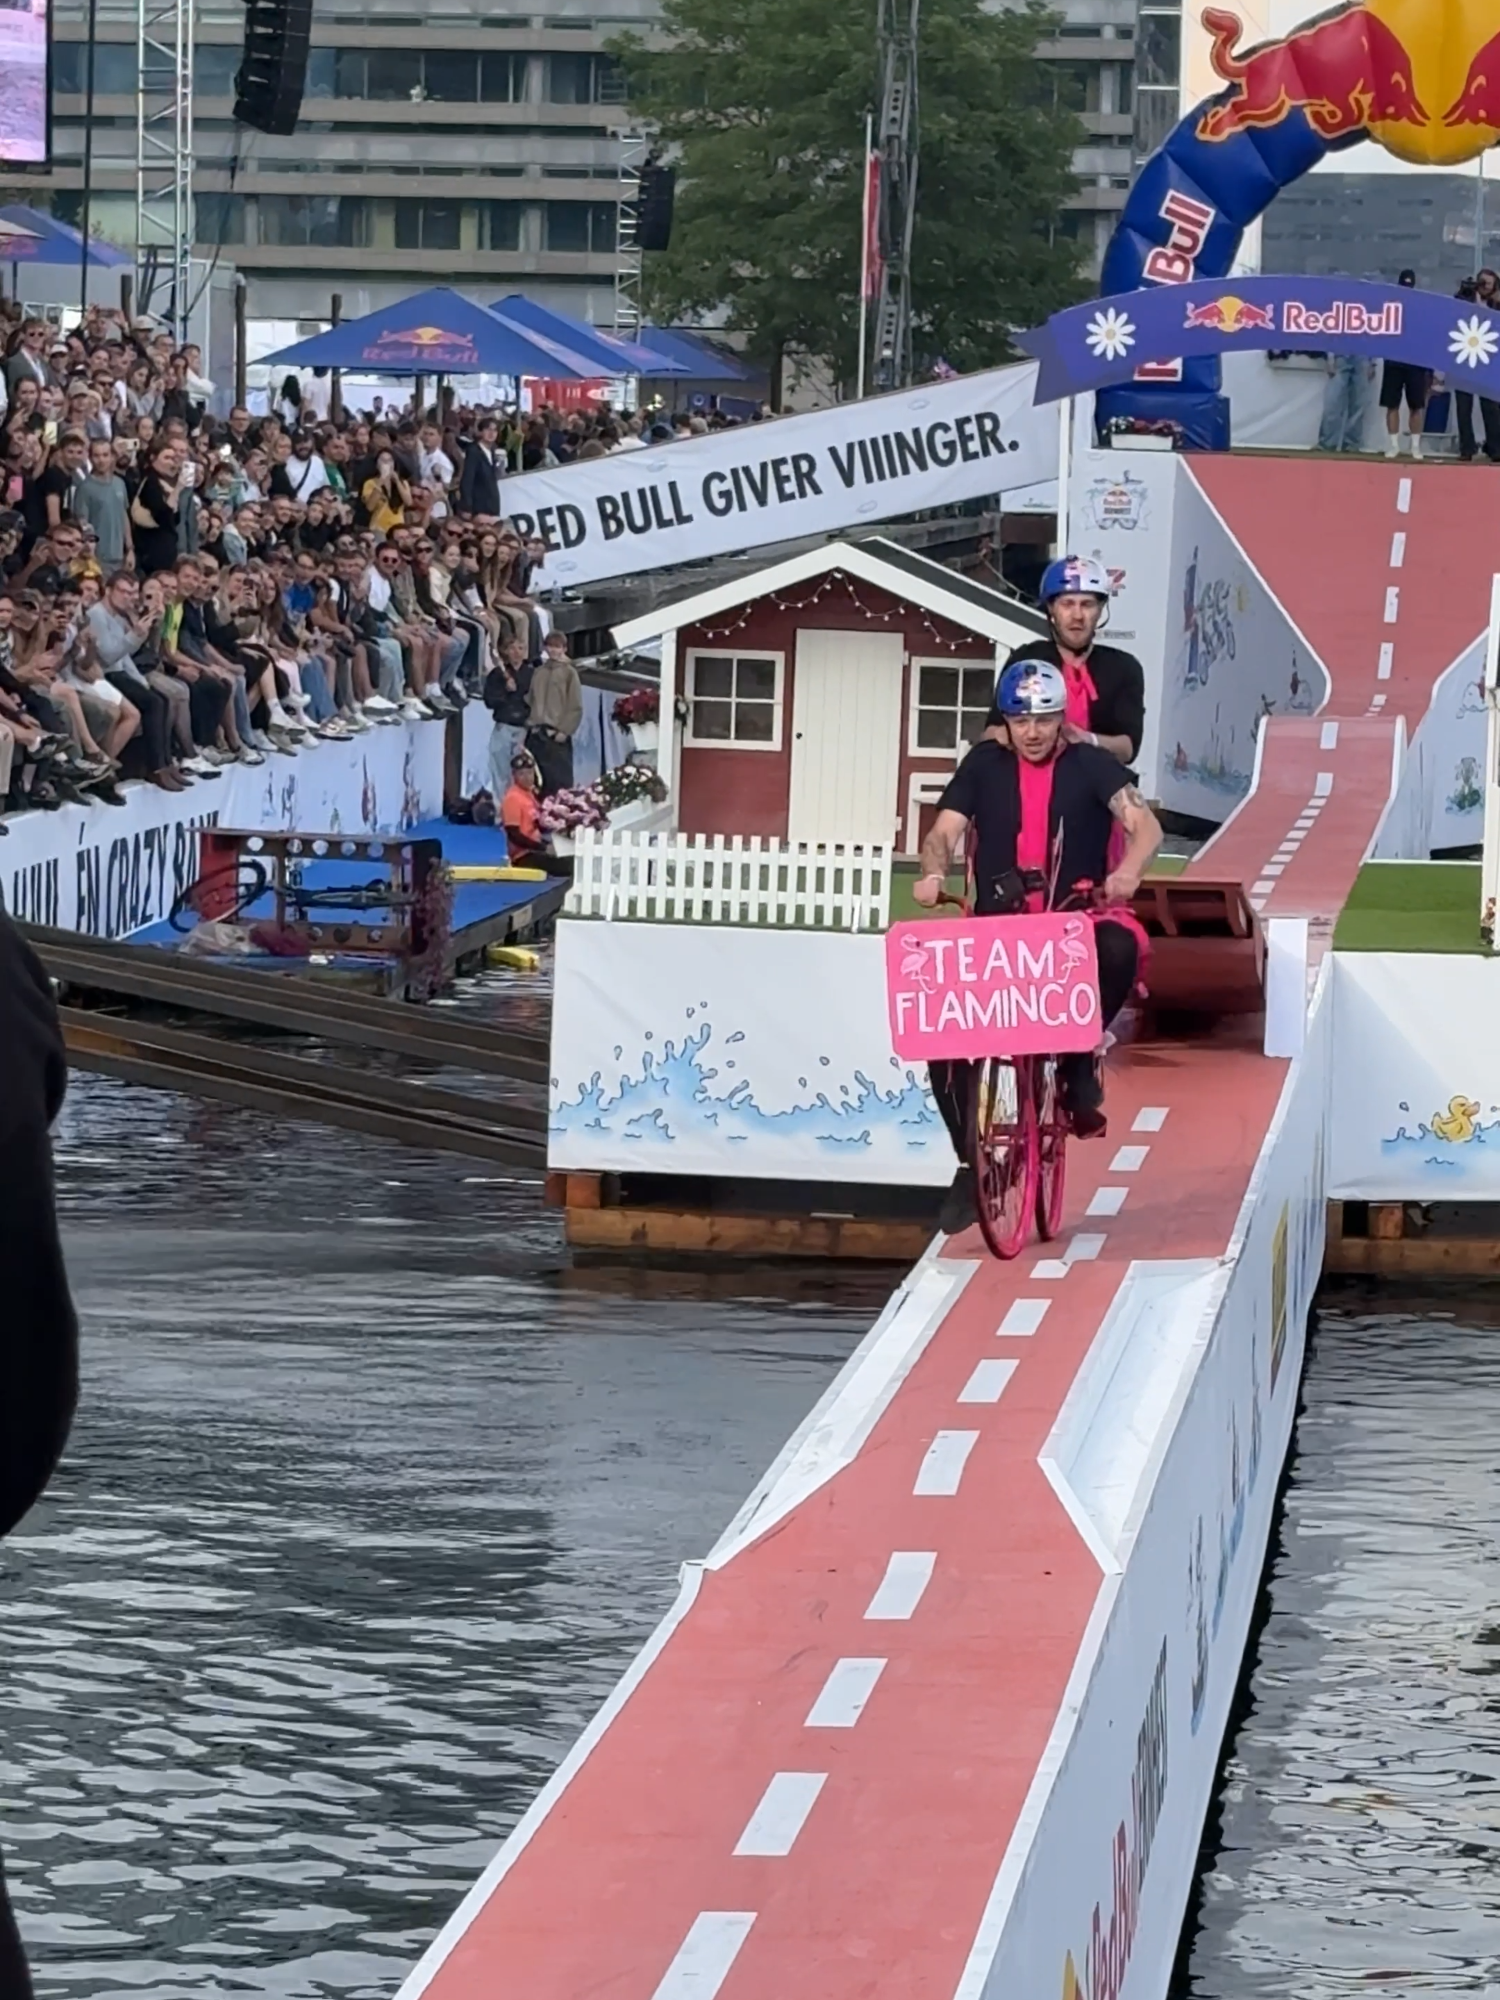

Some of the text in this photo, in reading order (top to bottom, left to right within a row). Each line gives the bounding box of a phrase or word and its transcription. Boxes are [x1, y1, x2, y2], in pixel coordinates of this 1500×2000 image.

[1144, 190, 1214, 284] Bull
[1283, 302, 1402, 334] Red Bull
[596, 481, 693, 540] BULL
[702, 452, 822, 517] GIVER
[828, 411, 1019, 488] VIIINGER.
[106, 823, 169, 938] CRAZY
[924, 937, 1053, 984] TEAM
[896, 982, 1096, 1035] FLAMINGO
